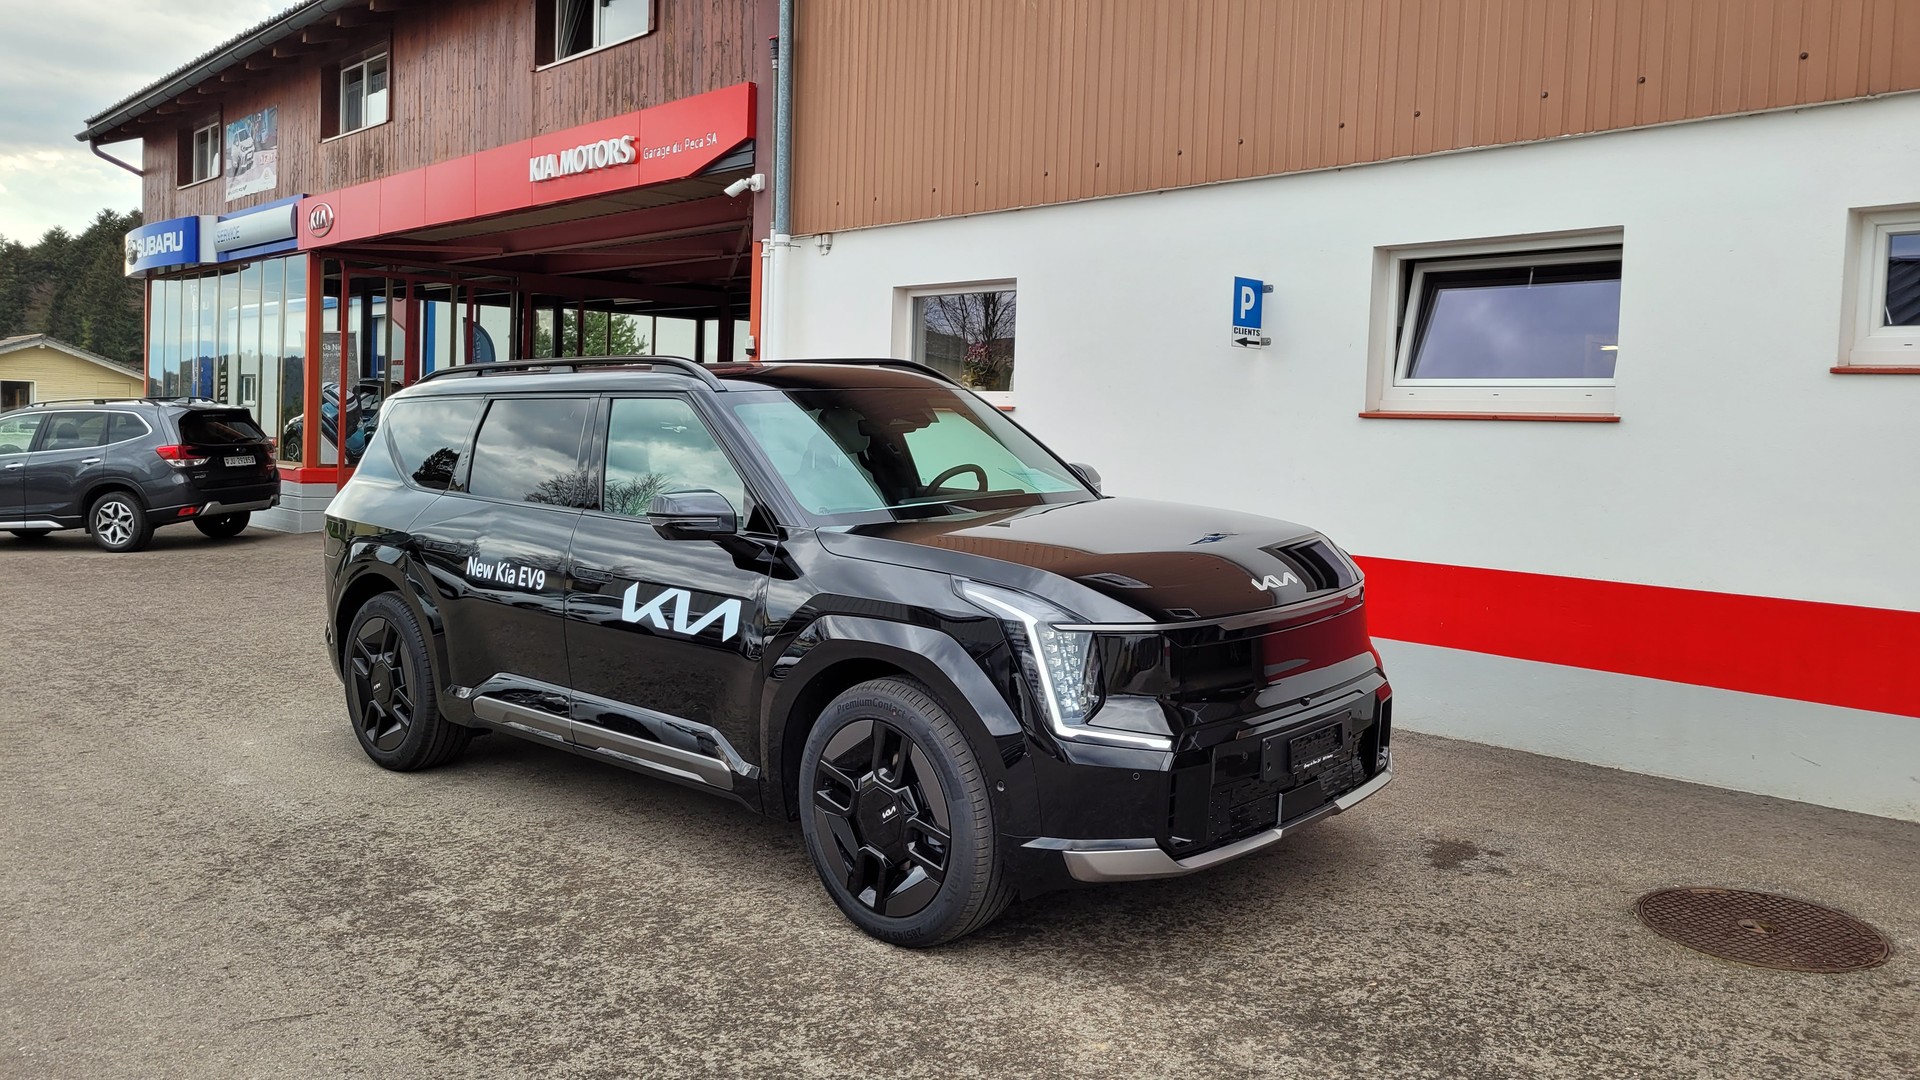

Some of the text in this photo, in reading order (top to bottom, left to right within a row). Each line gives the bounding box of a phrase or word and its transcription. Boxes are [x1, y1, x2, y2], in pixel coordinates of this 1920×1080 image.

[529, 135, 636, 182] KIA MOTORS
[643, 132, 718, 161] Garage du Peca SA
[310, 208, 330, 230] KIA
[137, 230, 184, 259] SUBARU
[217, 225, 240, 243] SERVICE
[1240, 285, 1256, 320] P
[1233, 326, 1261, 337] CLIENTS
[466, 556, 546, 590] New Kia EV9
[1251, 571, 1298, 591] KIA
[622, 581, 742, 643] KIA
[836, 697, 907, 720] PremiumContact
